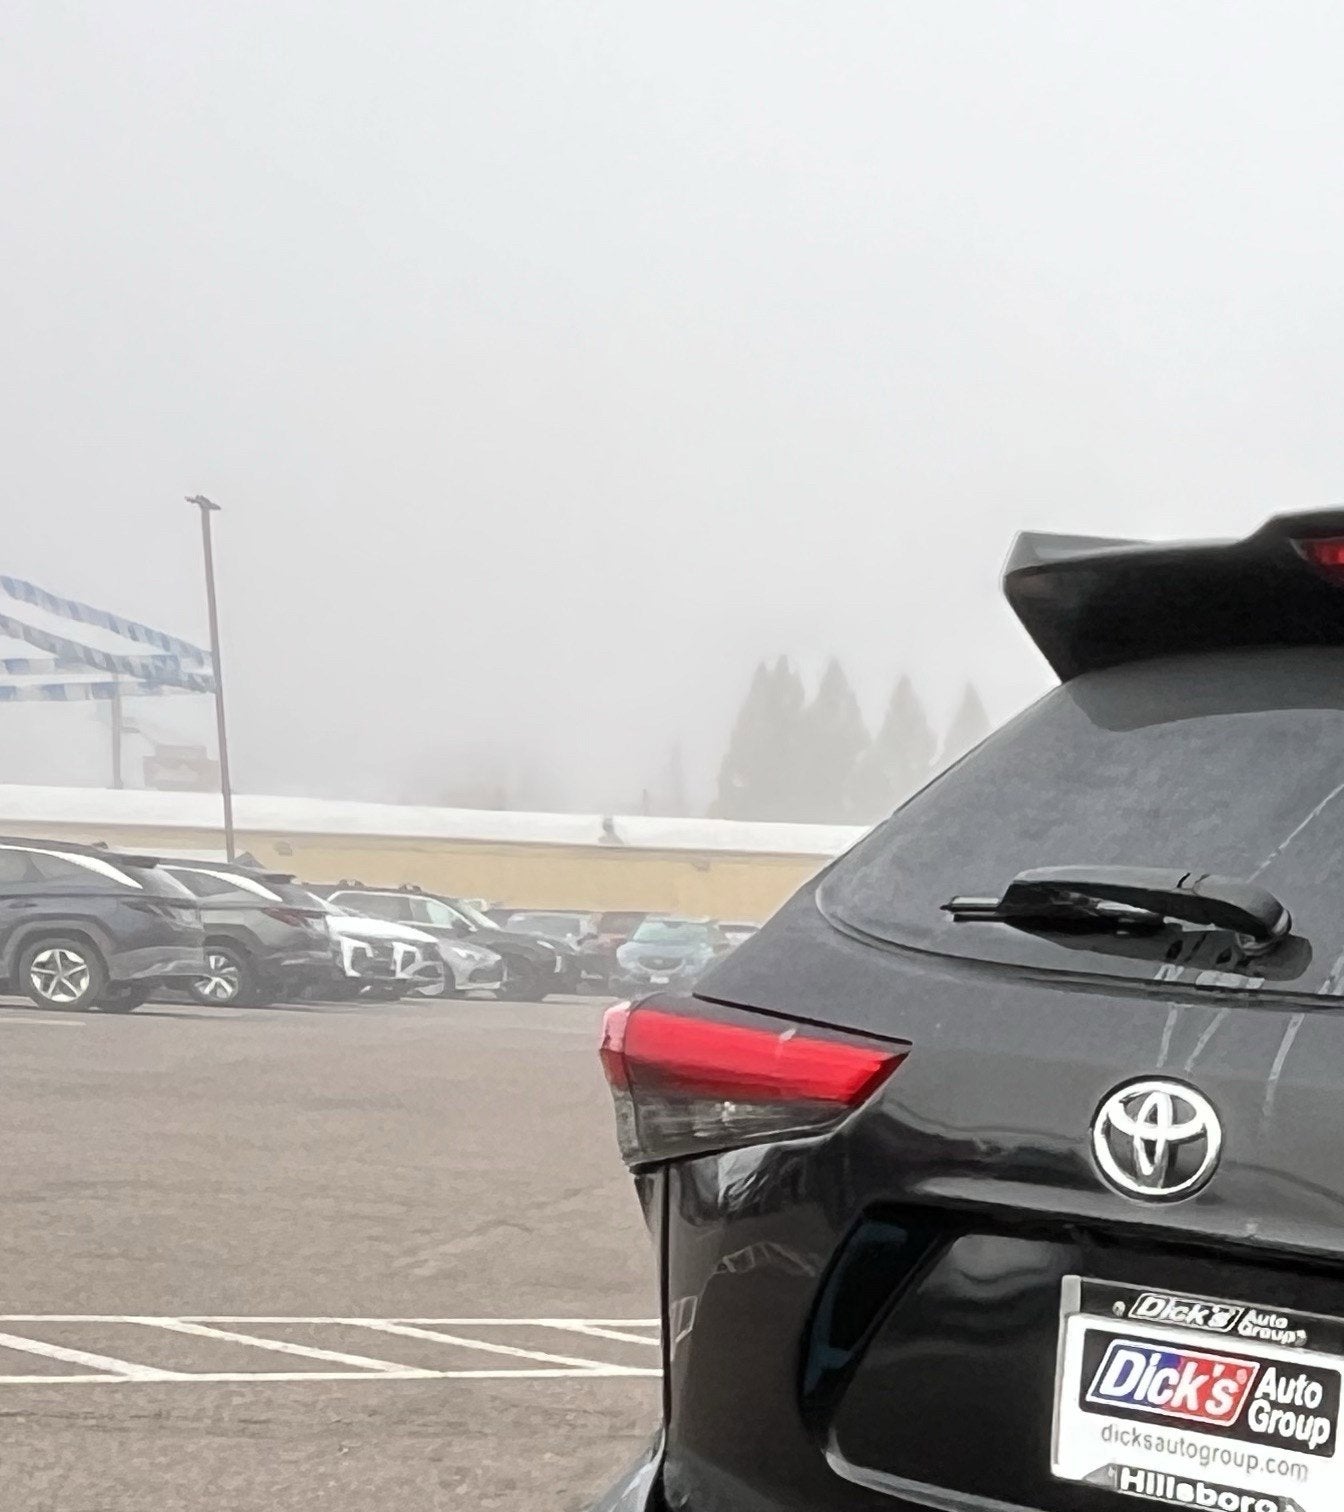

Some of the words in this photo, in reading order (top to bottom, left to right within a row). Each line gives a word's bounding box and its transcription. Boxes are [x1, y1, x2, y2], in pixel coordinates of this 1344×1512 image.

[1136, 1297, 1231, 1328] Dick's
[1237, 1321, 1297, 1344] Group
[1244, 1309, 1288, 1329] Auto
[1099, 1349, 1241, 1416] Dick's
[1254, 1366, 1323, 1409] Auto
[1247, 1402, 1331, 1449] Group
[1101, 1423, 1309, 1483] dicksautogroup.com
